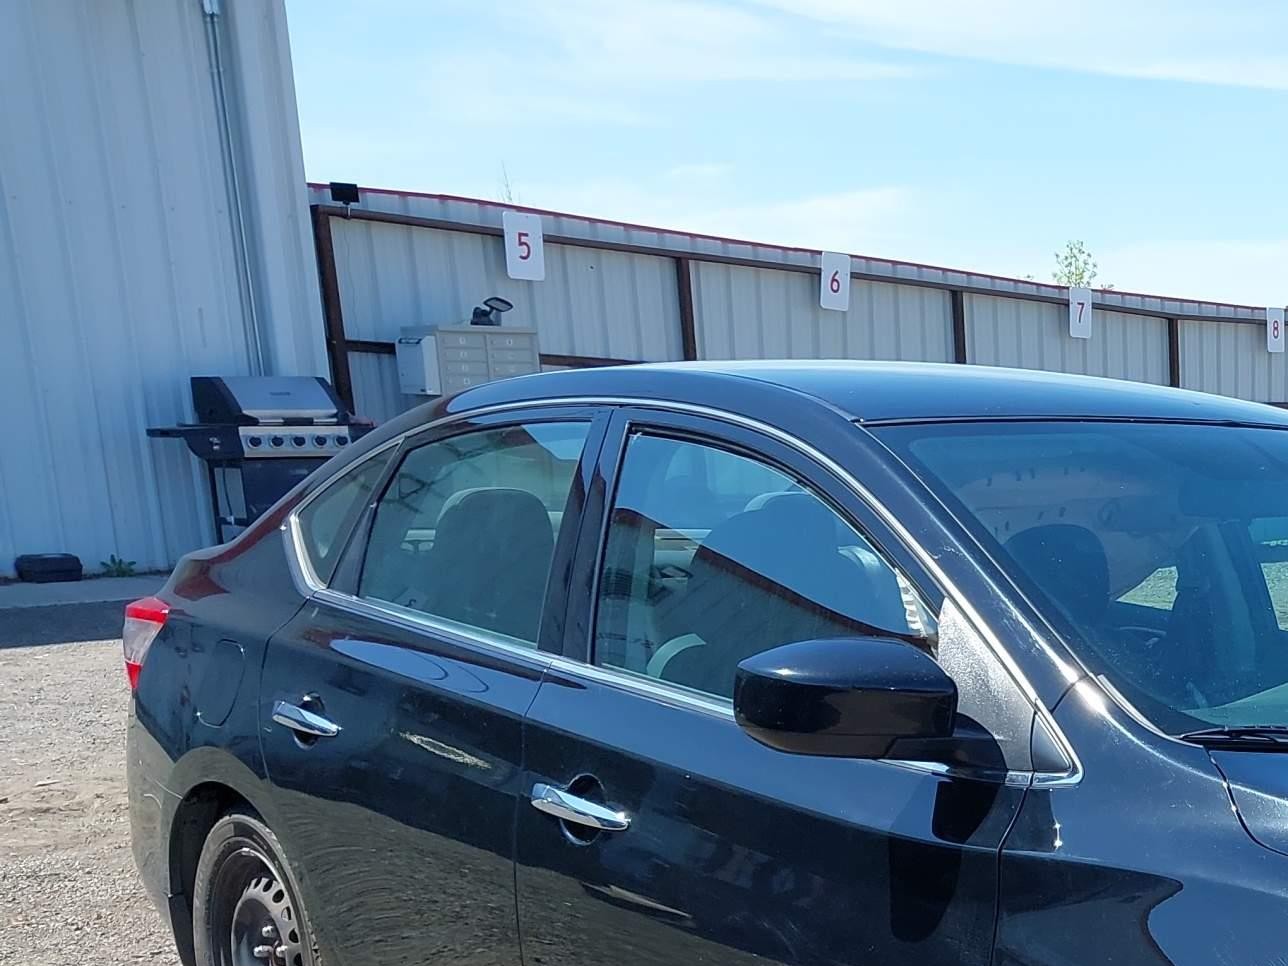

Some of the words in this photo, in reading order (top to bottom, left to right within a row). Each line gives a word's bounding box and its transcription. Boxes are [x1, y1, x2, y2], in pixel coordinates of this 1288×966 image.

[517, 231, 531, 260] 5
[830, 269, 840, 294] 6
[1076, 301, 1085, 324] 7
[1272, 319, 1280, 340] 8
